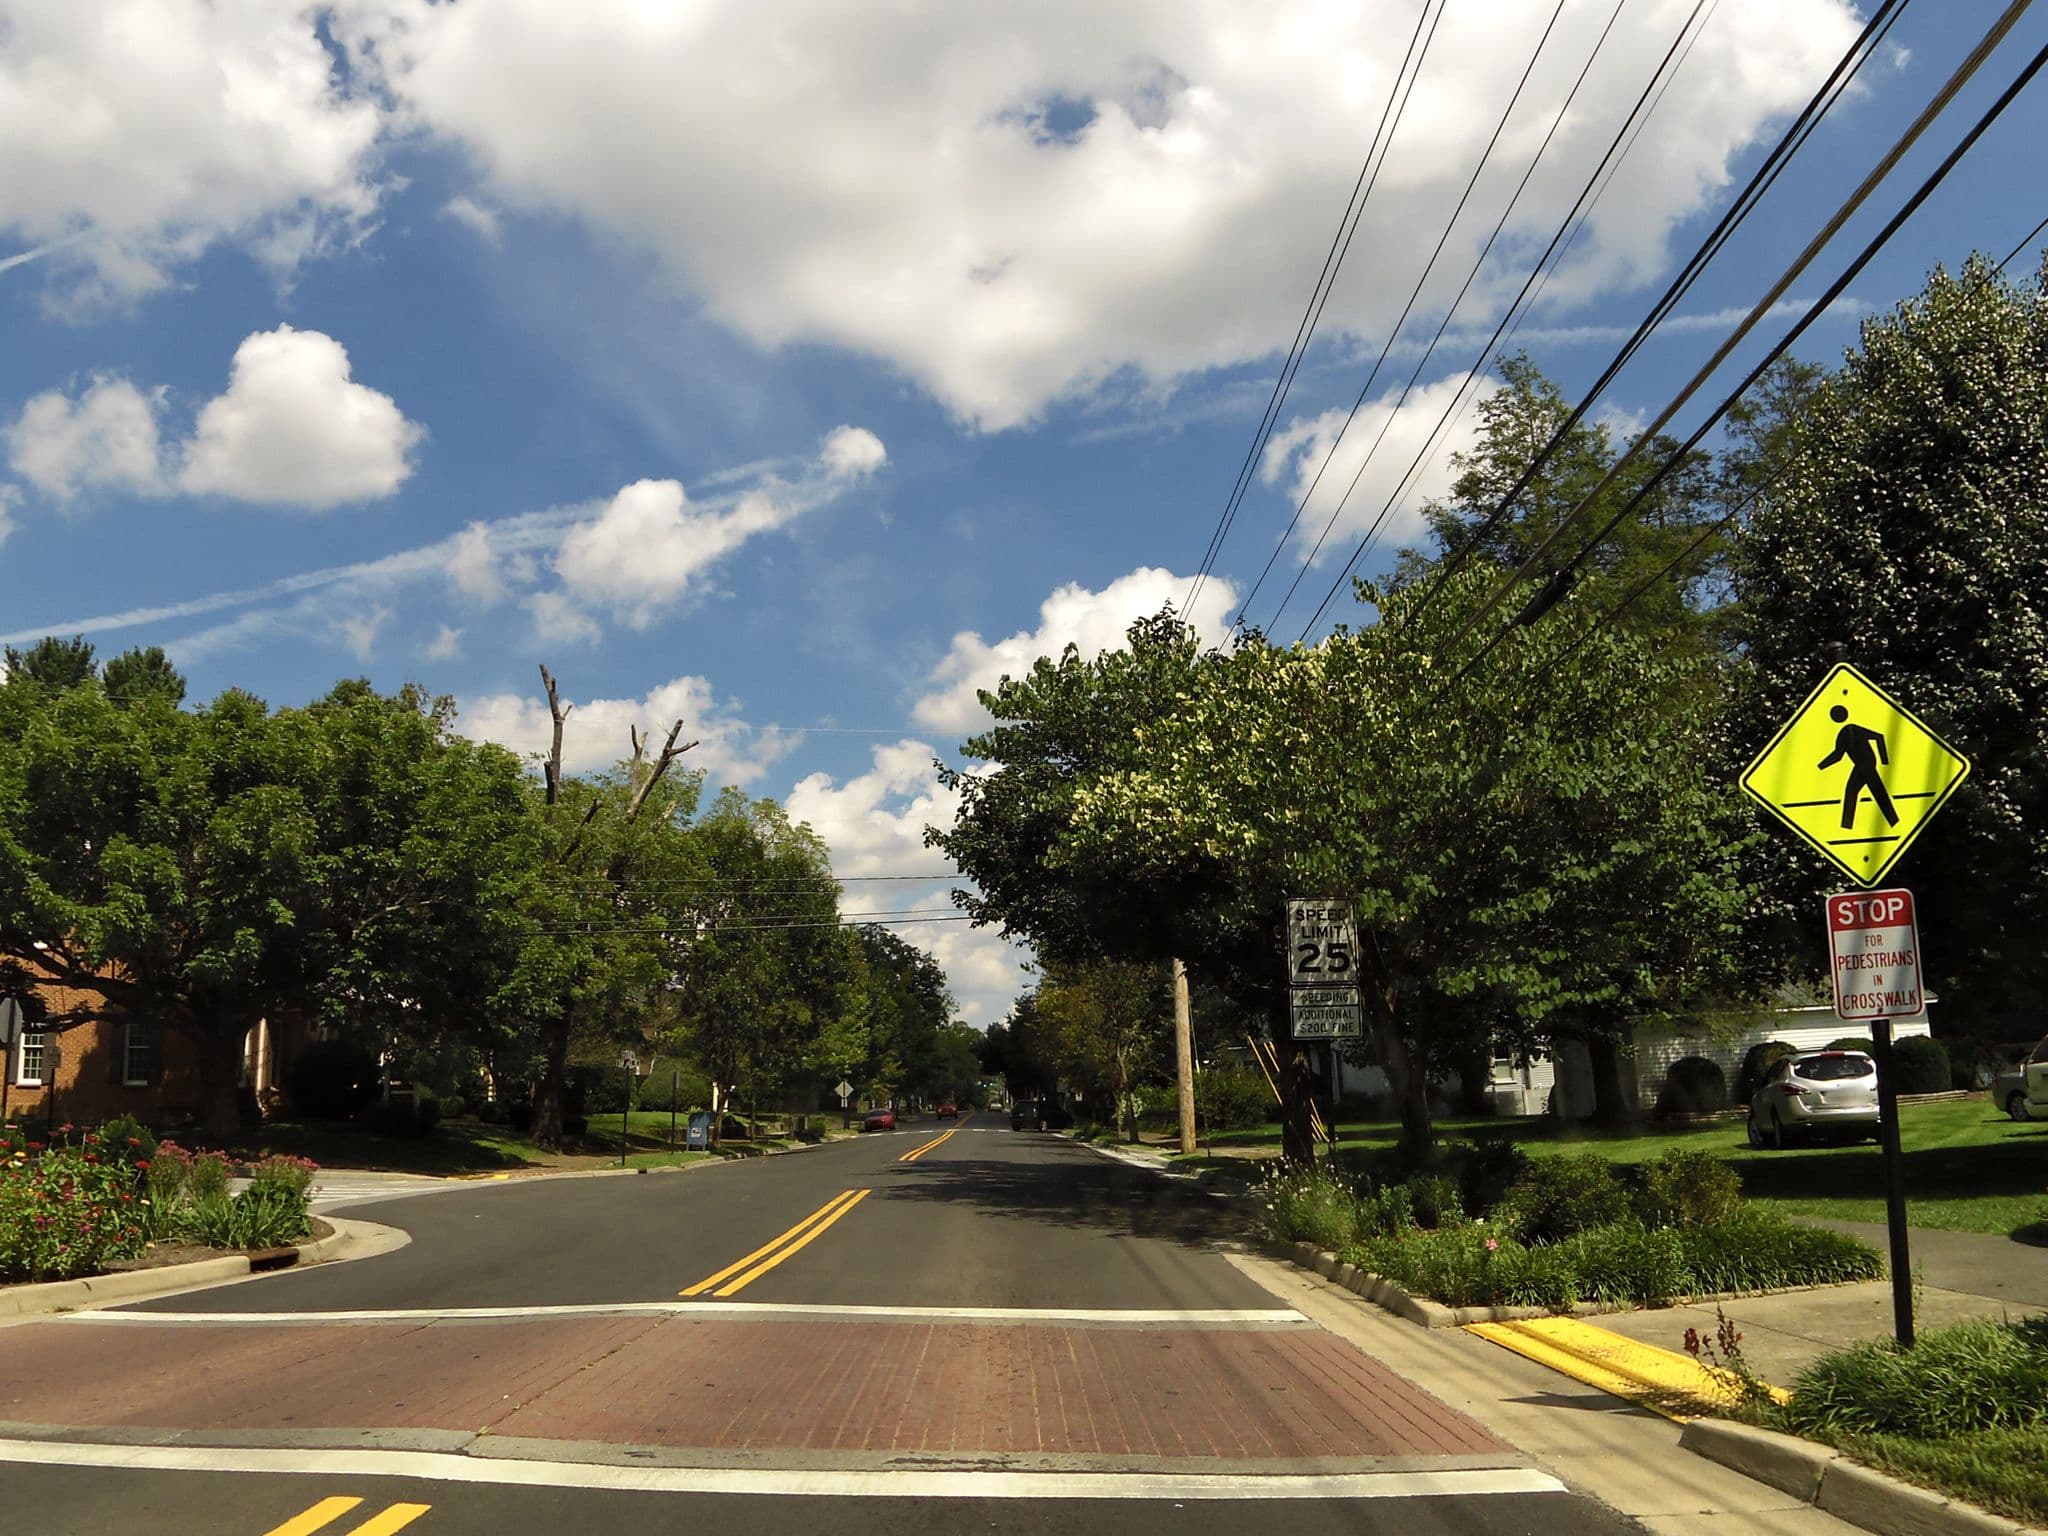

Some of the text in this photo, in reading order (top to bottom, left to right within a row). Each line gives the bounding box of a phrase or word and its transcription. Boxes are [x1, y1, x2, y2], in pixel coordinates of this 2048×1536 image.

[1838, 897, 1904, 925] STOP
[1301, 926, 1343, 939] LIMIT
[1865, 934, 1883, 947] FOR
[1297, 943, 1350, 973] 25
[1838, 950, 1914, 971] PEDESTRIANS
[1873, 974, 1883, 986] IN
[1301, 991, 1349, 1002] PEEDING
[1842, 989, 1917, 1011] CROSSWALK
[1332, 1022, 1354, 1033] FINE
